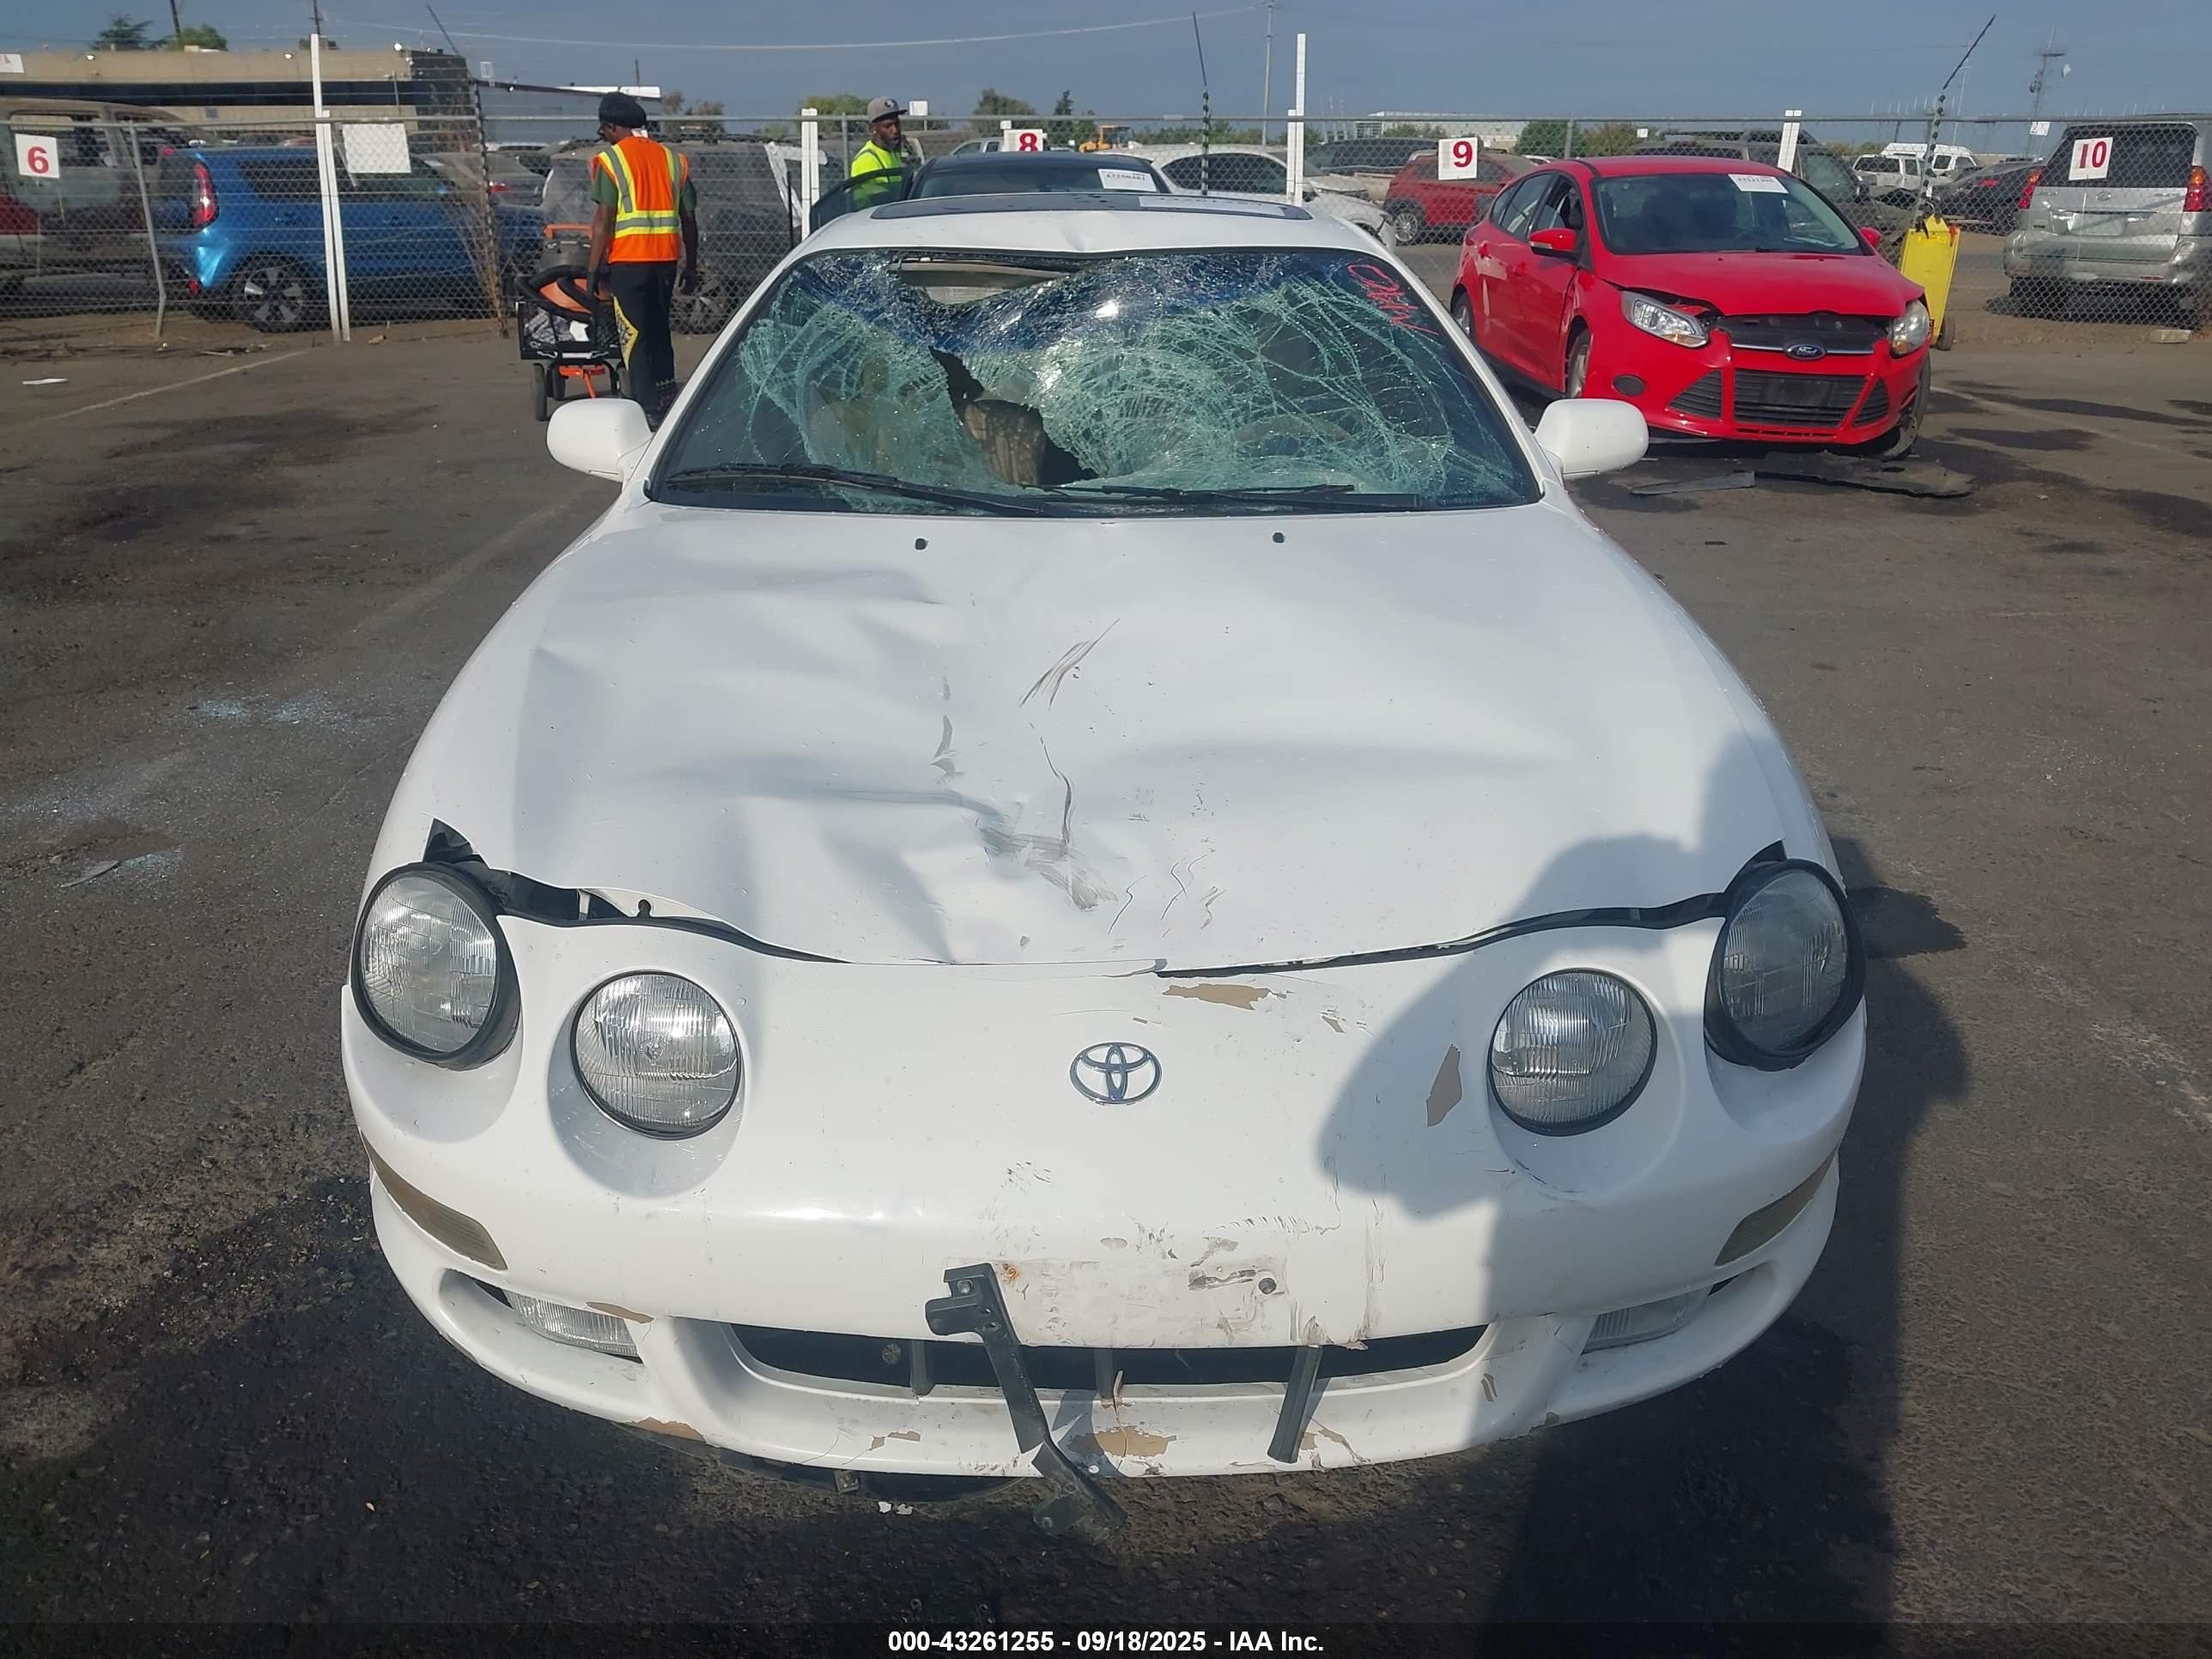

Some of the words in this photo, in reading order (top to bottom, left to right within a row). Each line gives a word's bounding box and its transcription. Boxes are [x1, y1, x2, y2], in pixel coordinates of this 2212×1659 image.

[1018, 132, 1038, 151] 8
[1453, 141, 1473, 167] 9
[2079, 141, 2107, 168] 10
[27, 146, 49, 173] 6
